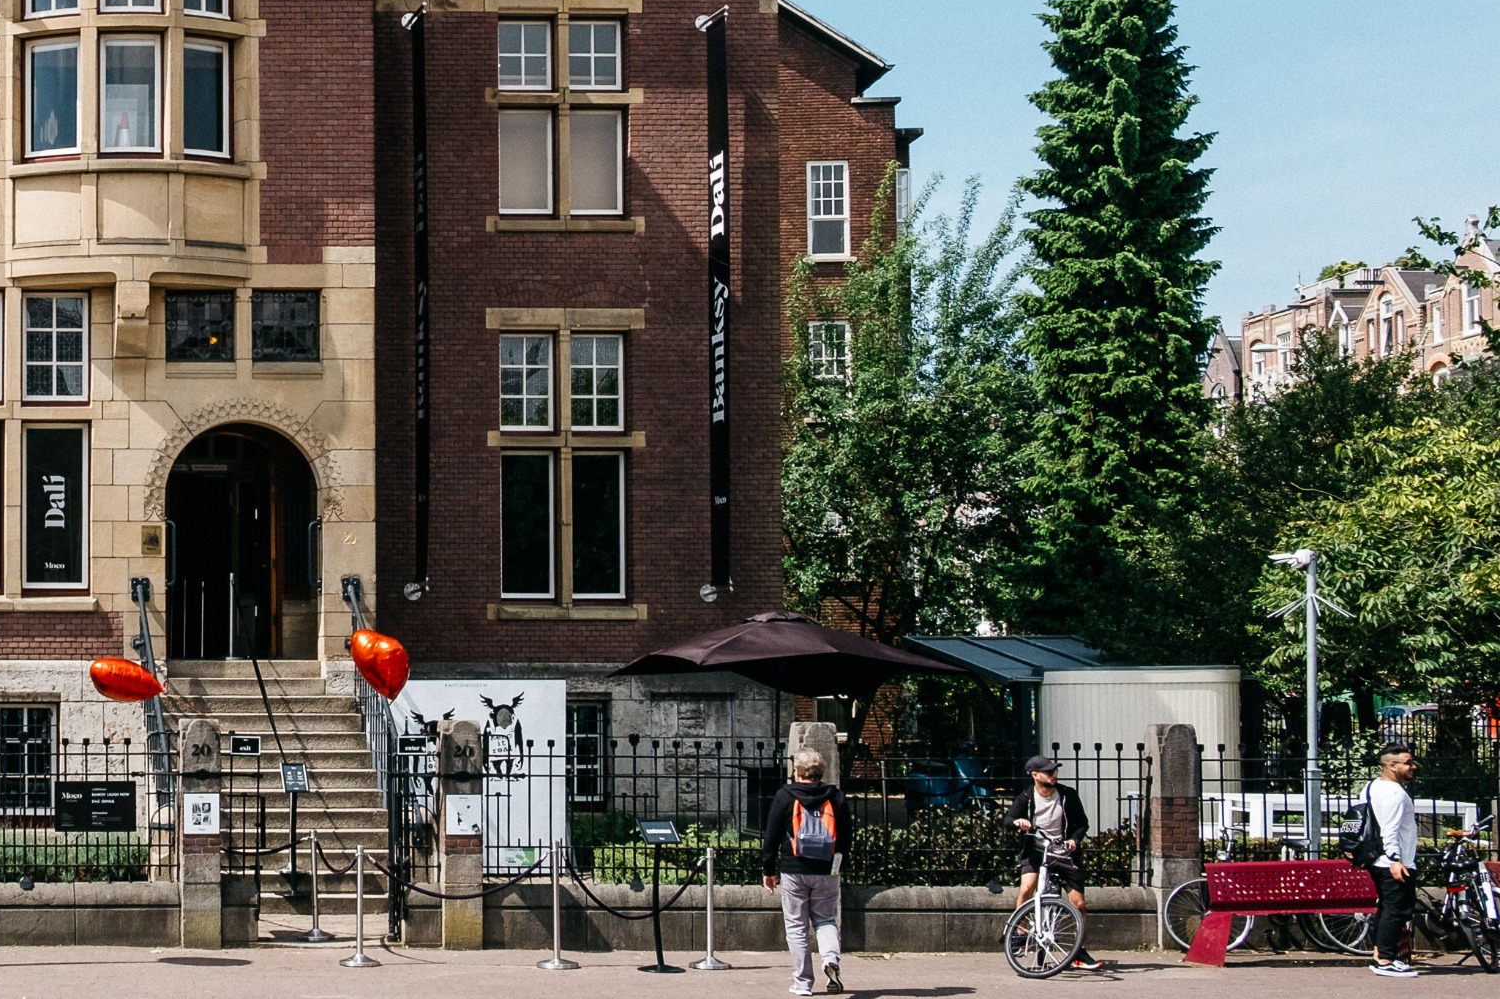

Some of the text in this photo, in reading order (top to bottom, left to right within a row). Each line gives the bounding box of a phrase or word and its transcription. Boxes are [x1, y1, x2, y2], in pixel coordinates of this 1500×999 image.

[709, 150, 724, 240] Dalí
[711, 275, 729, 425] Banksy
[42, 475, 66, 529] Dalí
[44, 562, 65, 570] Moco
[191, 743, 212, 756] 20
[454, 745, 474, 758] 20
[1340, 820, 1362, 833] ANS
